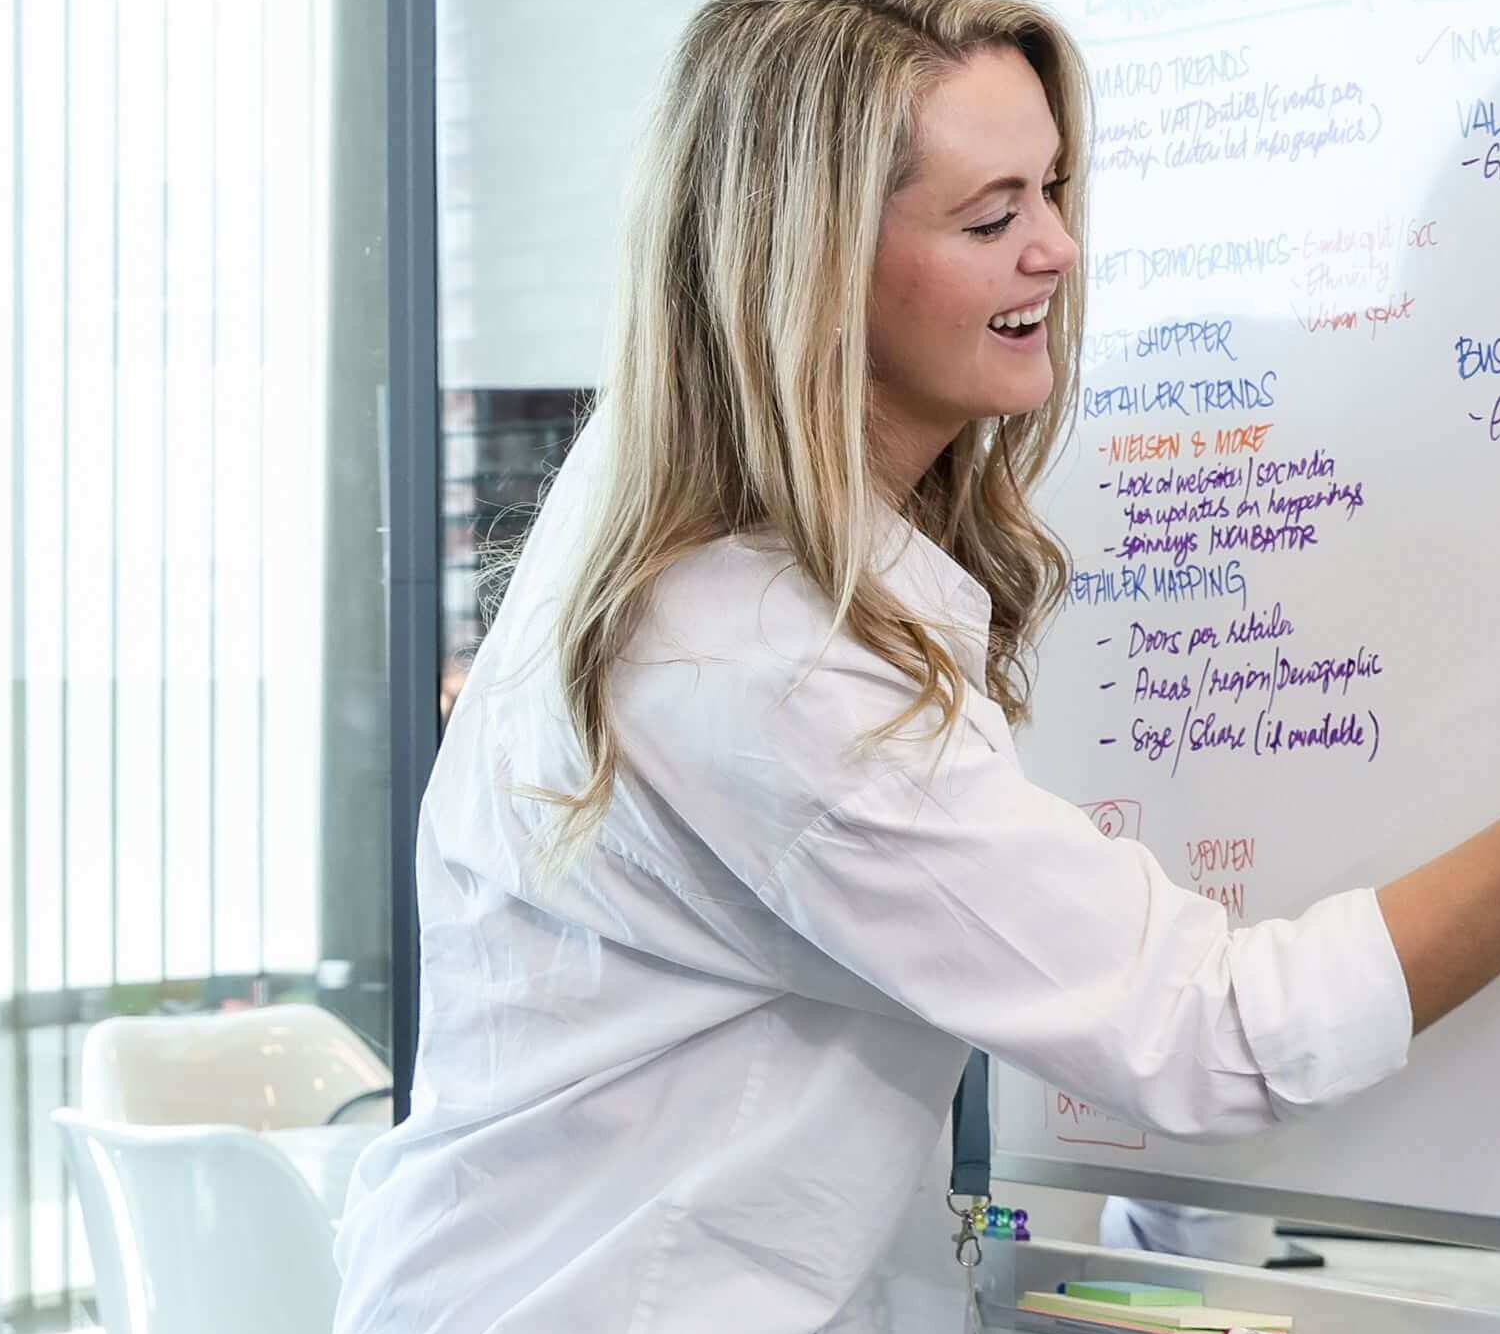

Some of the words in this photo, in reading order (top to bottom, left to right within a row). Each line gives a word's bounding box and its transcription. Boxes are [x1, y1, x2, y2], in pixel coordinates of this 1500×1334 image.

[1137, 319, 1238, 361] SHOPPER
[1082, 379, 1190, 420] RETAILER
[1190, 372, 1277, 415] TRENDS
[1108, 434, 1181, 465] NIELSEN
[1213, 424, 1275, 455] MORE
[1153, 560, 1248, 611] MAPPING
[1128, 621, 1182, 659] Doors
[1187, 624, 1220, 656] per
[1225, 602, 1295, 645] retailer
